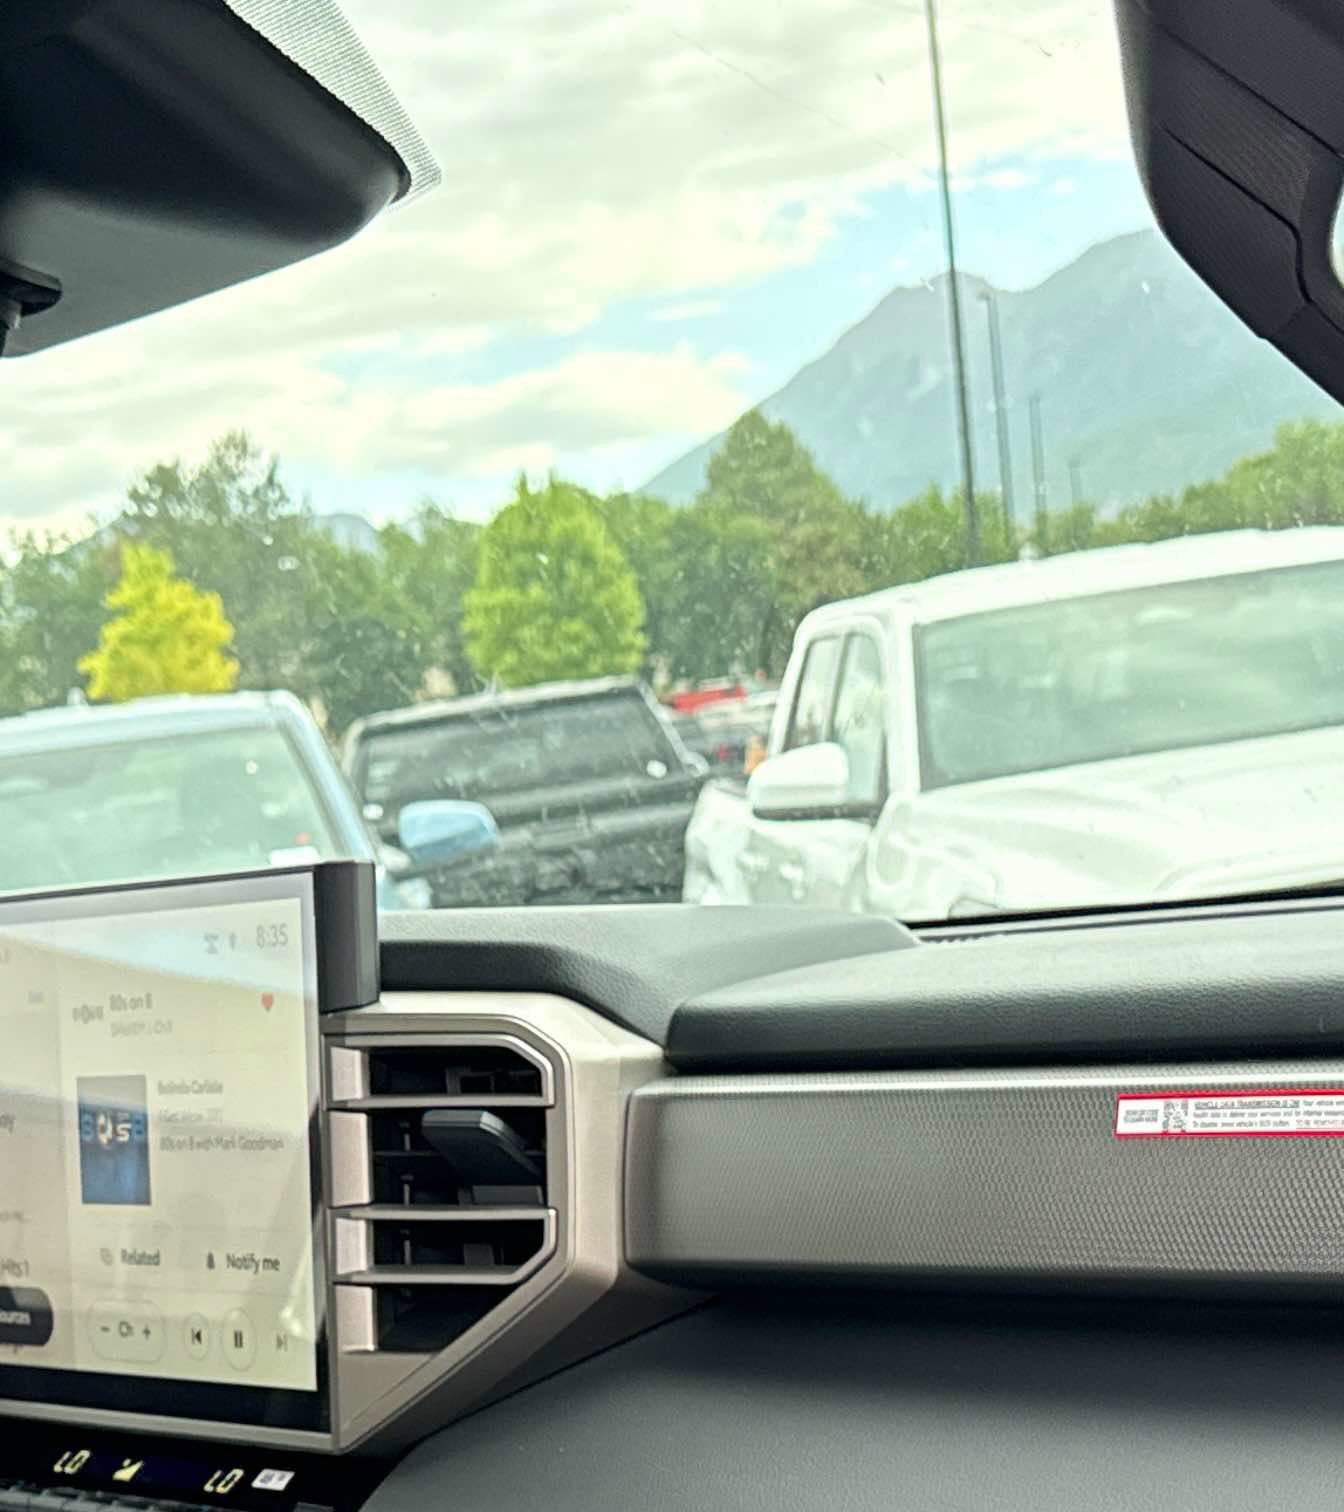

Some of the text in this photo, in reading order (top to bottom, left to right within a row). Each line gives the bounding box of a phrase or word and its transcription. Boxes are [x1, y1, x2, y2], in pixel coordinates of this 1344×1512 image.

[255, 923, 289, 949] 8:35
[120, 1249, 161, 1267] Related
[226, 1253, 281, 1274] Notify me
